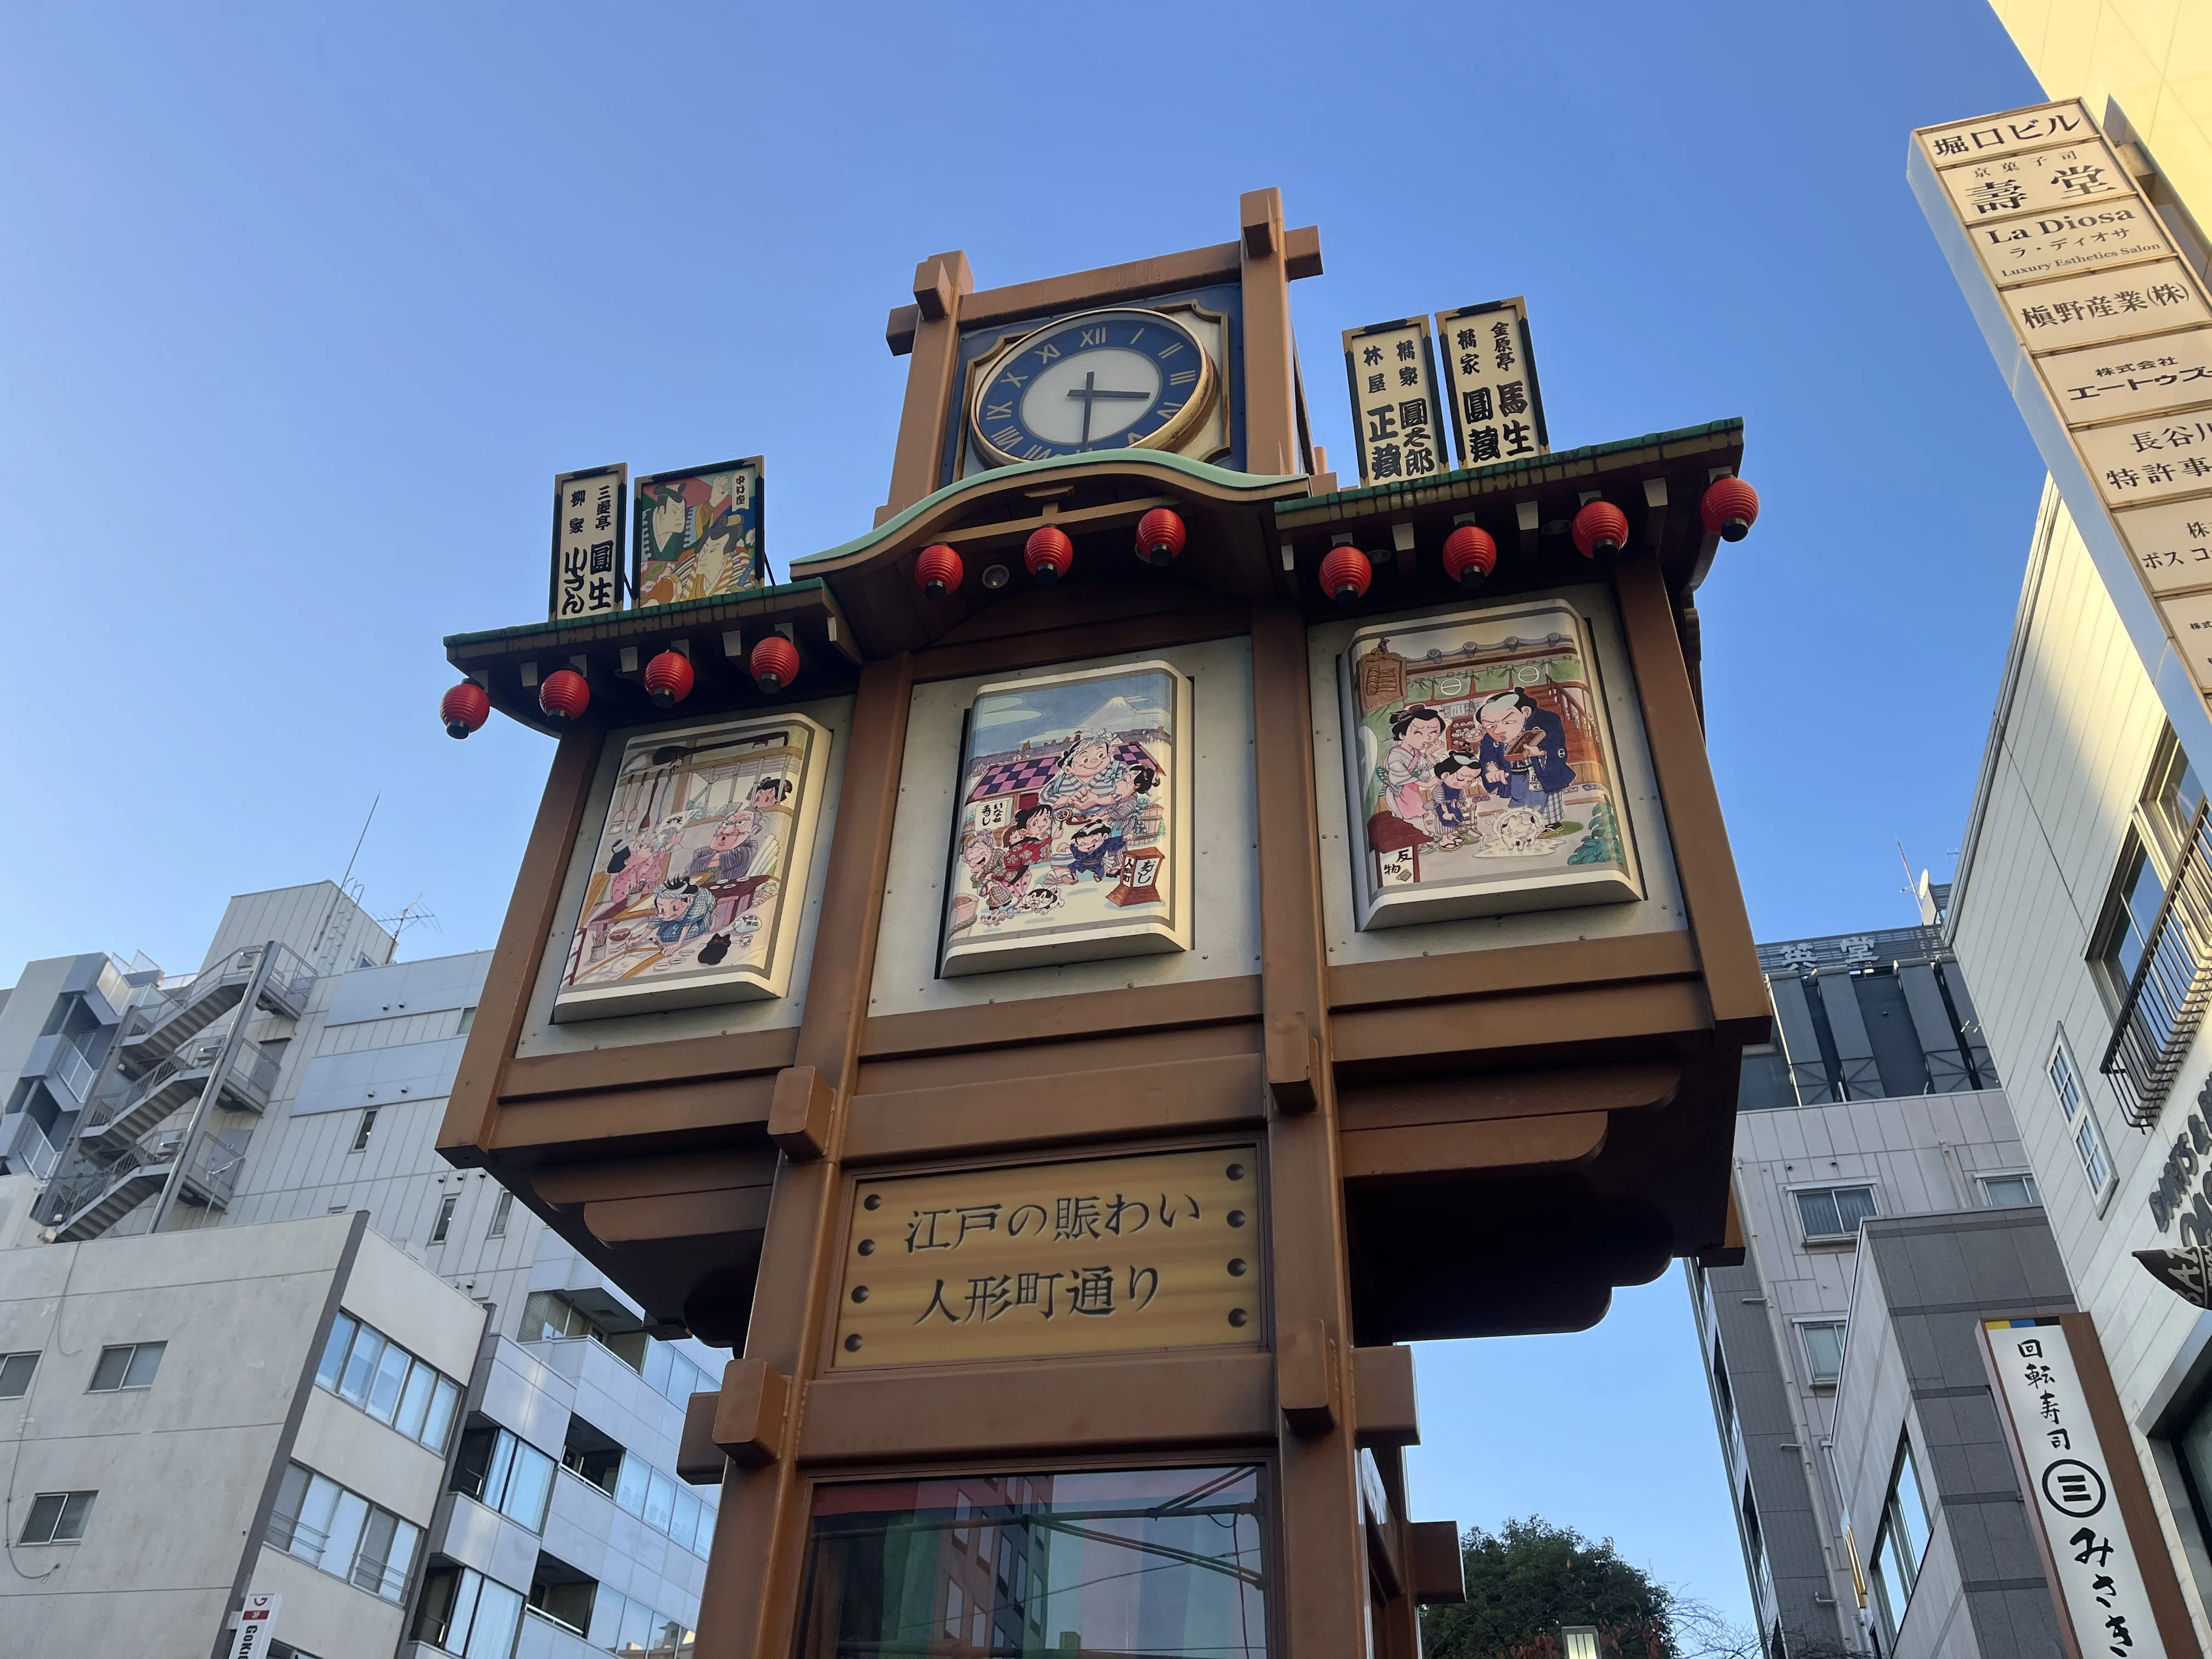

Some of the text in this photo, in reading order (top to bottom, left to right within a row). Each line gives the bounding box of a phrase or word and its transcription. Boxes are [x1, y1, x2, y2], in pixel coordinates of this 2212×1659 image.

[1933, 115, 2080, 156] 堀口ビル
[1974, 150, 2078, 178] 京菓子司
[1985, 210, 2136, 244] La Diosa
[2001, 243, 2160, 277] Luxury Esthetics Salon
[1080, 326, 1106, 347] XII
[2067, 366, 2212, 400] エートウズ
[2095, 356, 2179, 377] 株式会社
[2187, 521, 2212, 539] 株
[992, 803, 1003, 822] いなせ
[905, 1193, 1201, 1254] 江戸の賑わい
[913, 1265, 1160, 1325] 人形町通り
[2017, 1339, 2072, 1450] 回転寿司
[2069, 1527, 2134, 1658] みさき
[238, 1625, 258, 1659] GOKI
